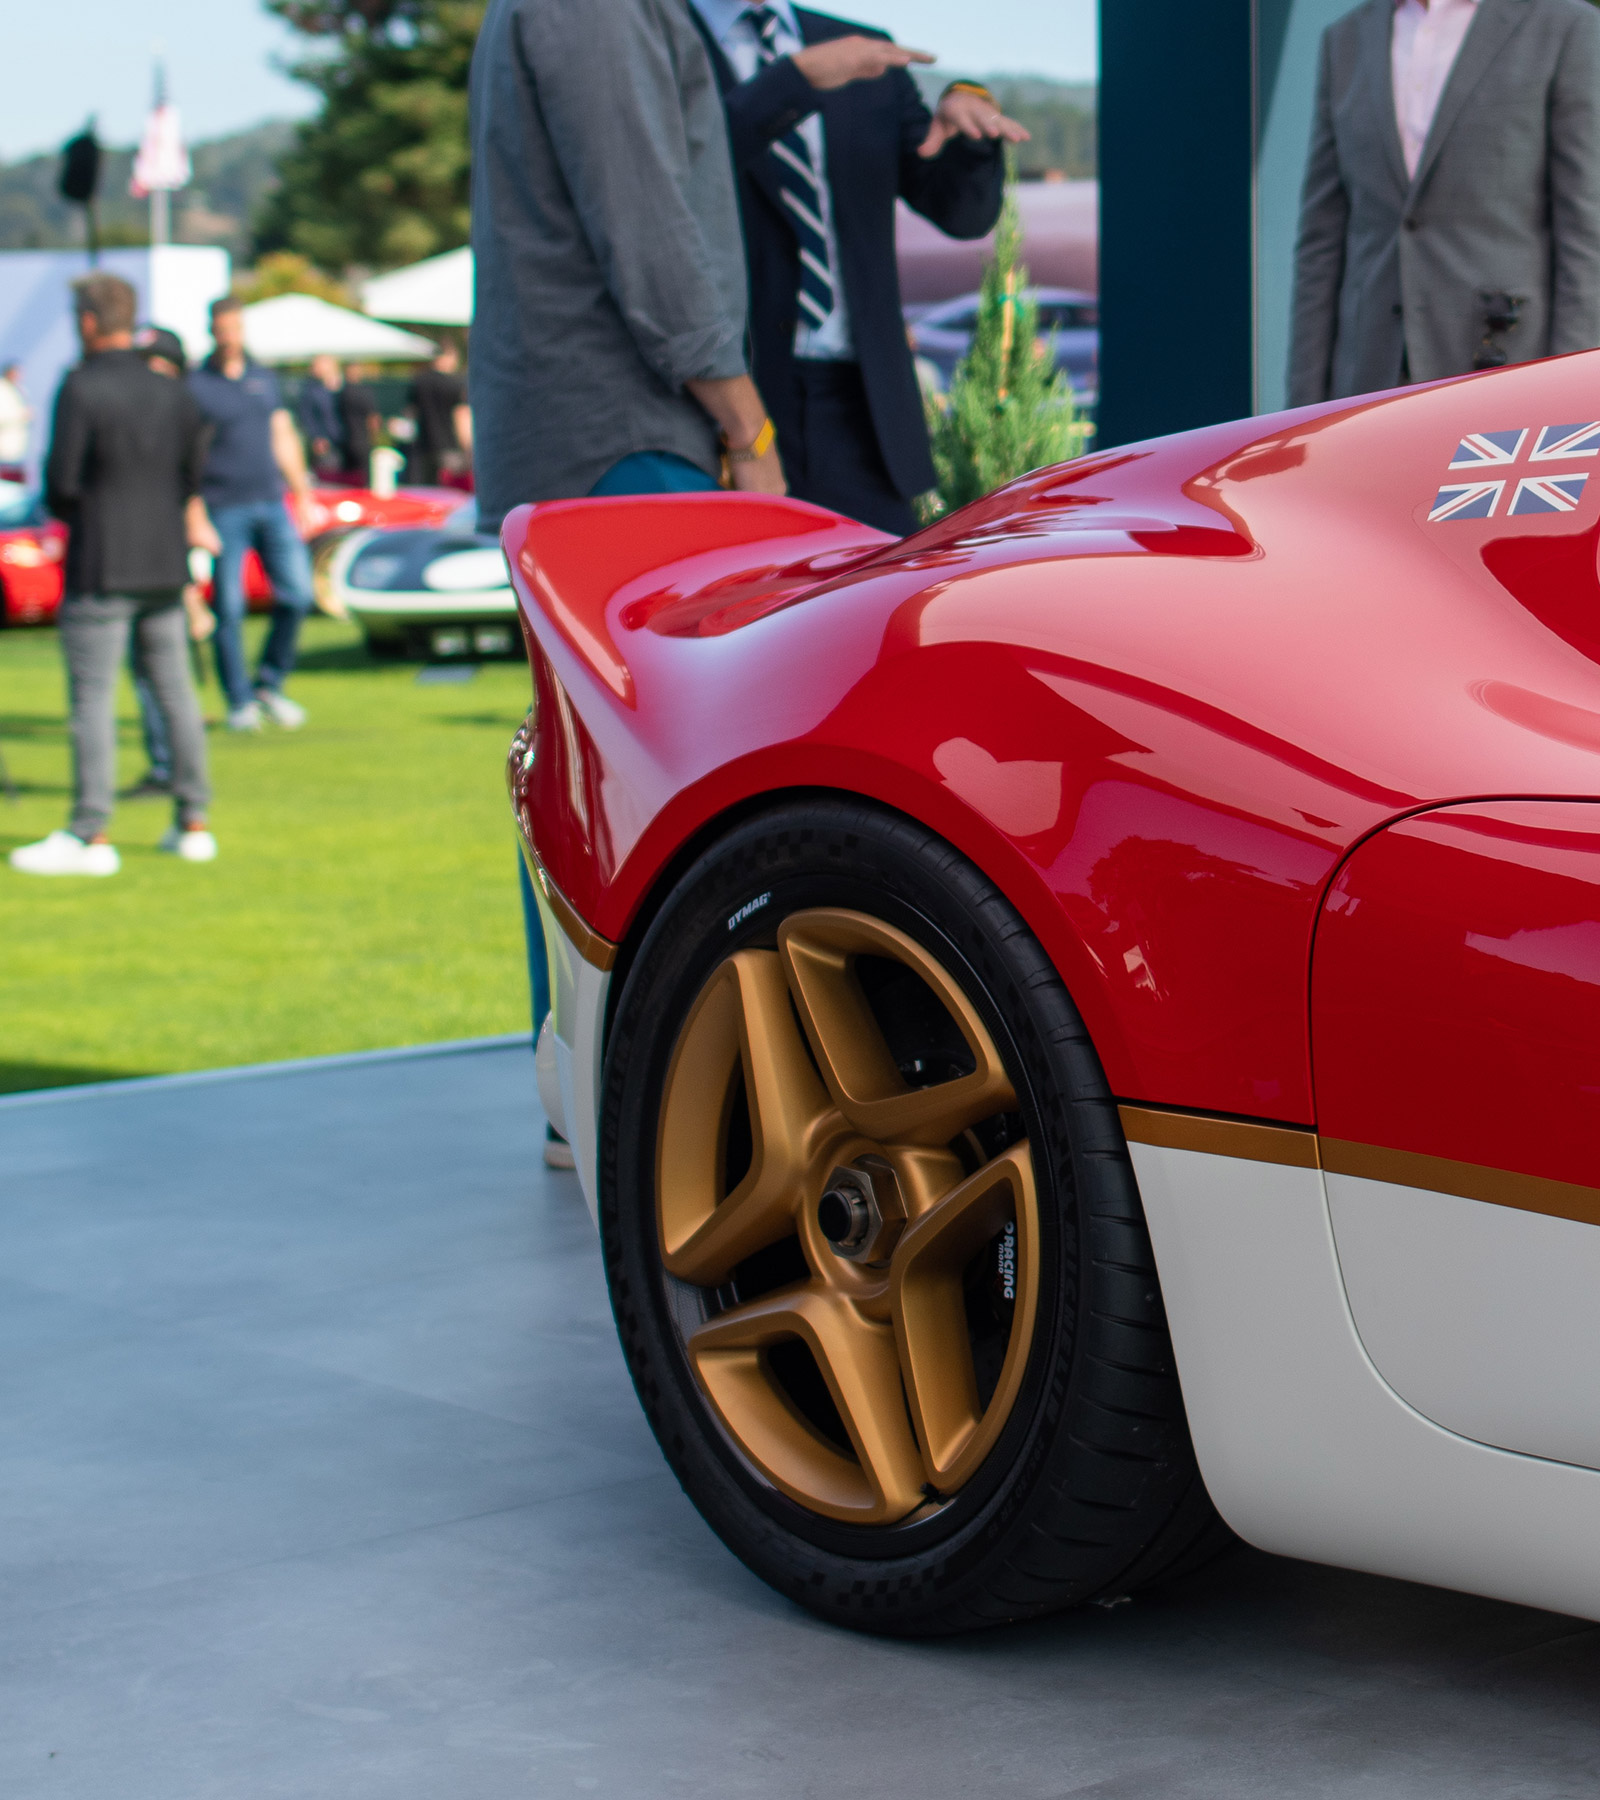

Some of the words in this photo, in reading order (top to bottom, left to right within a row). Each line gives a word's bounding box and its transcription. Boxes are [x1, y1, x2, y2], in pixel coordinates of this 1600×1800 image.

[728, 892, 770, 930] DYMAG
[1003, 1235, 1015, 1300] RACING
[1046, 1221, 1077, 1425] MICHELIN
